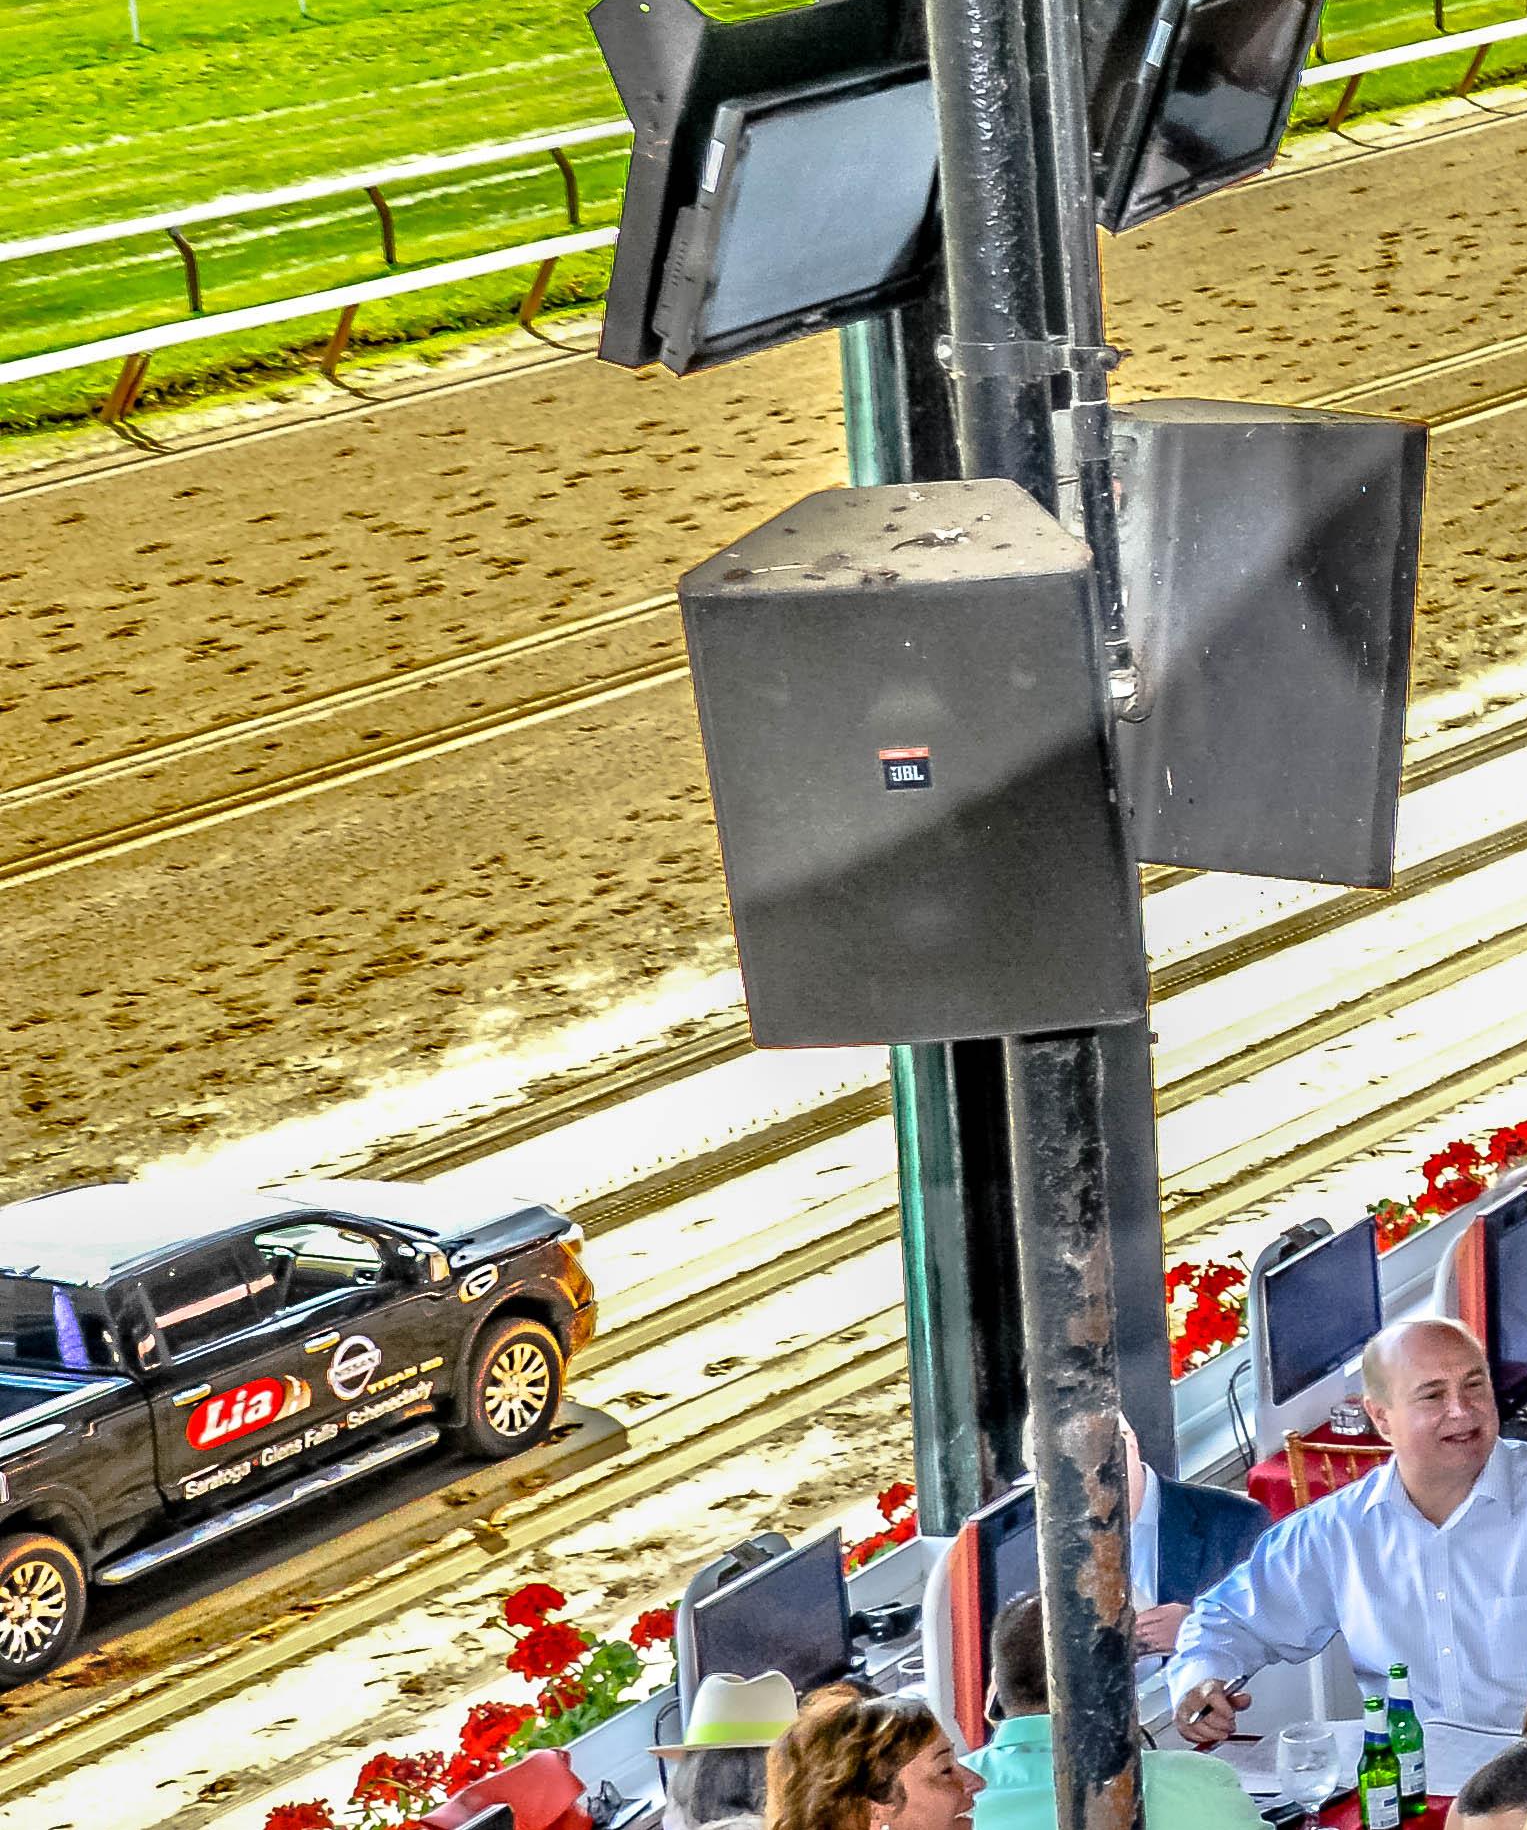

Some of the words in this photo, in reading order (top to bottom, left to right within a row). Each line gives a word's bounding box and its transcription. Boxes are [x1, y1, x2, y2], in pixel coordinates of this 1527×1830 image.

[890, 765, 925, 782] JBL
[199, 1389, 274, 1444] Lia
[185, 1461, 251, 1500] Saratoga
